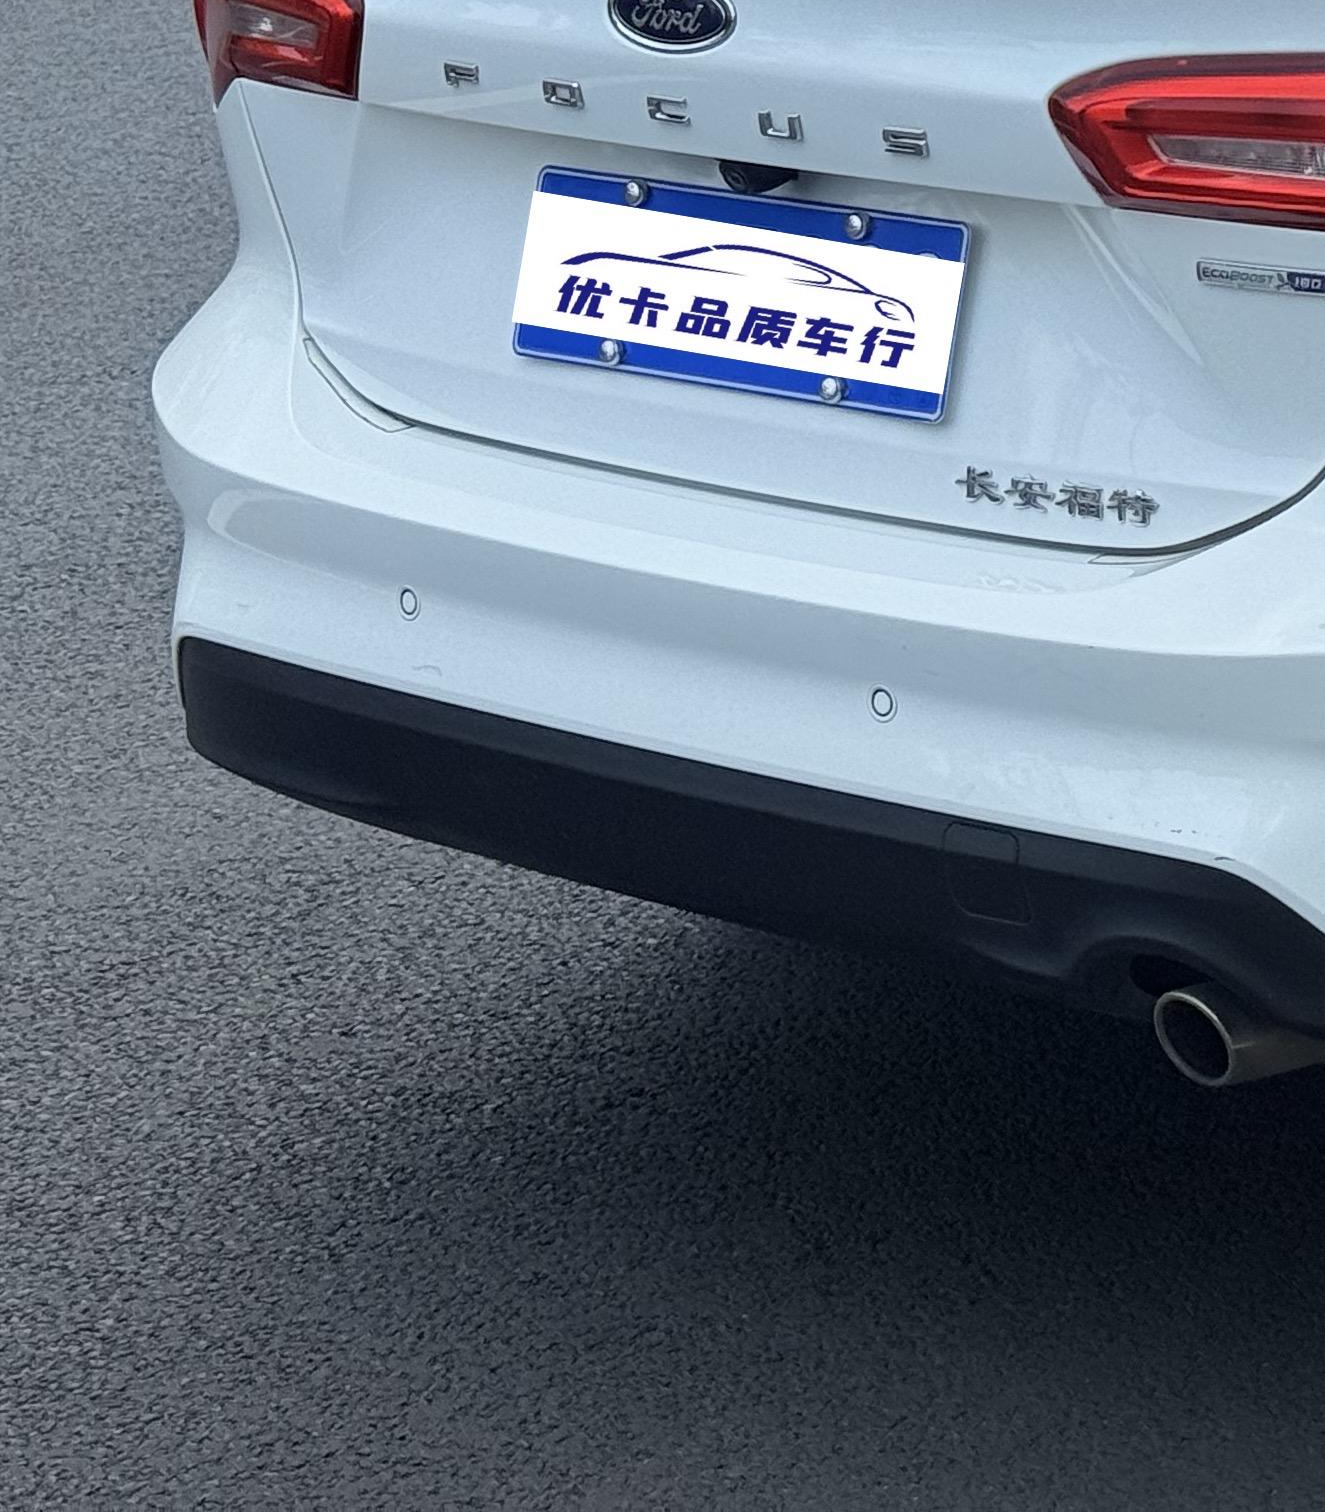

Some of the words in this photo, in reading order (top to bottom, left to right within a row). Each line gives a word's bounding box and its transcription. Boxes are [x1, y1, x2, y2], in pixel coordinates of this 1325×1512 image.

[443, 60, 930, 159] FOCUS
[955, 464, 1160, 528] 长安福特
